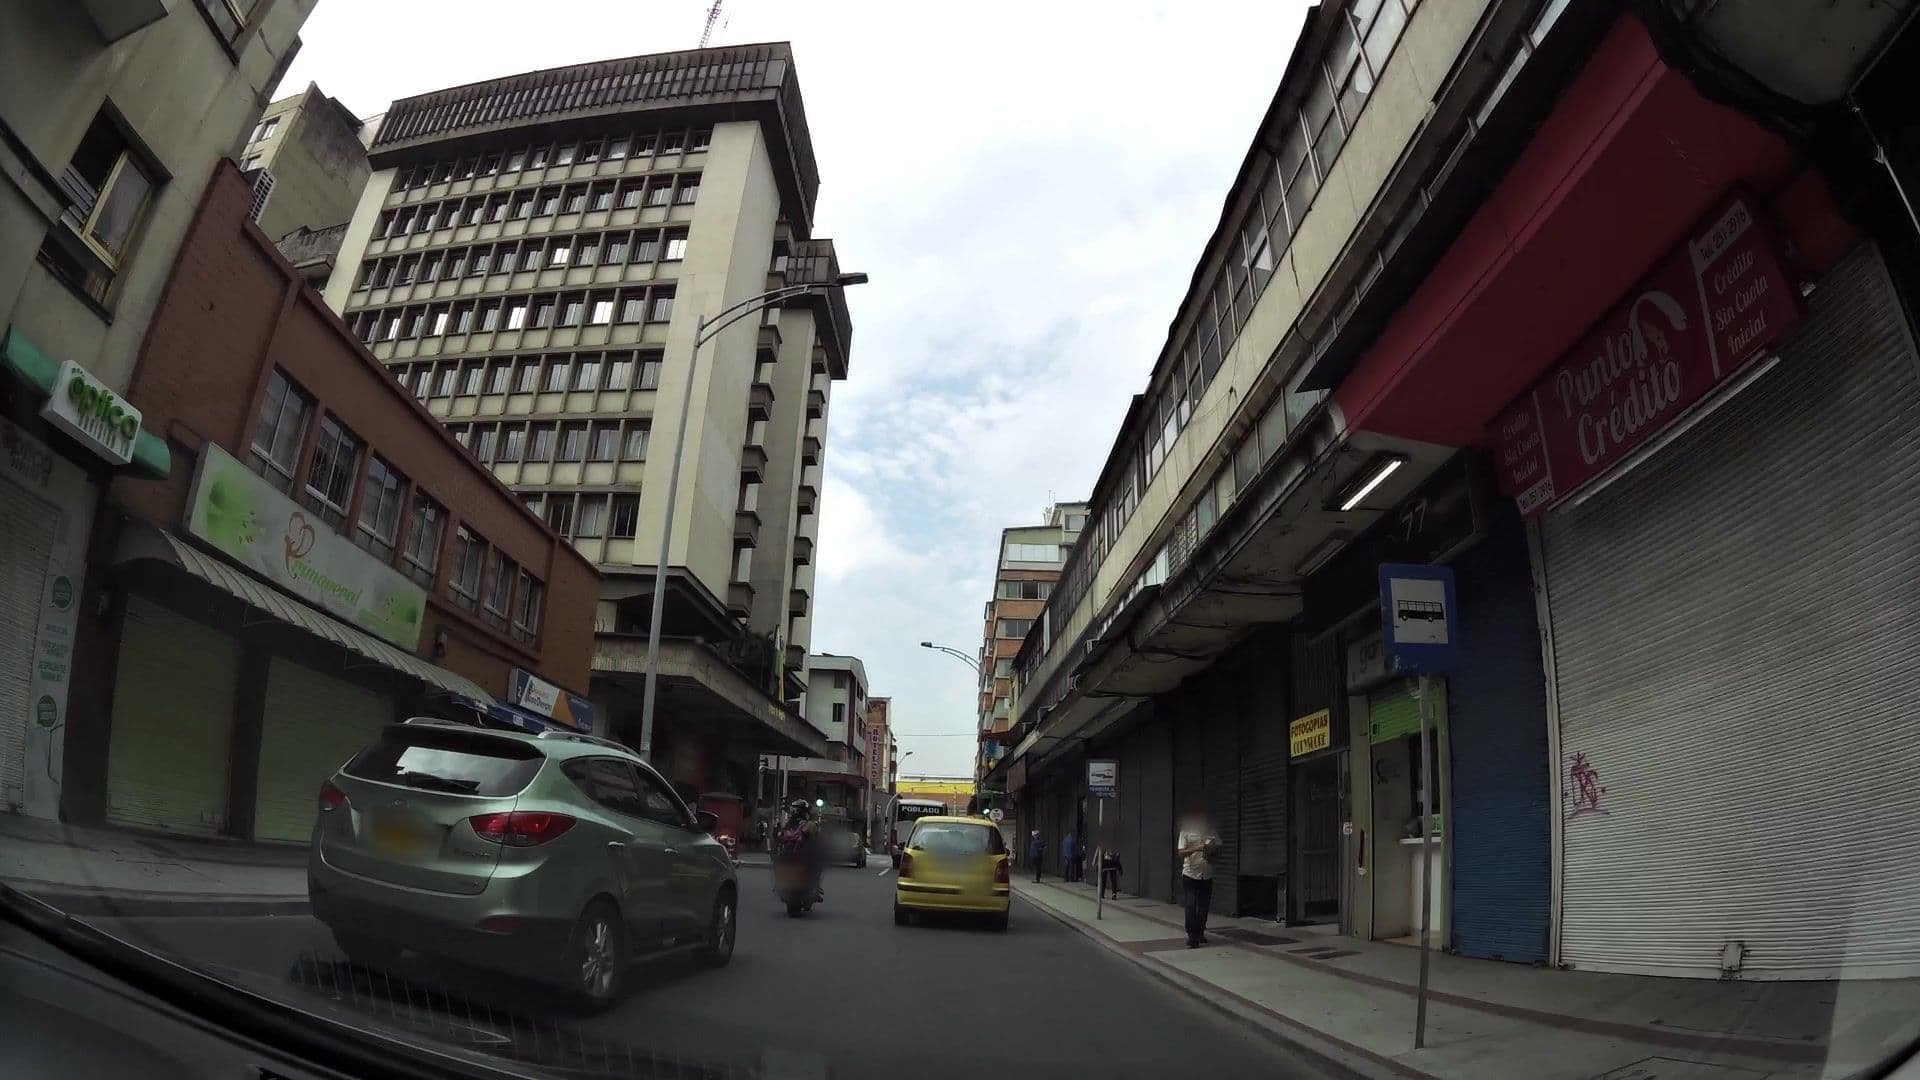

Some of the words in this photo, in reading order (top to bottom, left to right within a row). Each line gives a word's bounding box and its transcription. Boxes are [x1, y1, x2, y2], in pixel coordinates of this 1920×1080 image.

[1735, 275, 1769, 313] Cuota
[1555, 331, 1633, 419] Punto
[1578, 360, 1681, 464] Crédito
